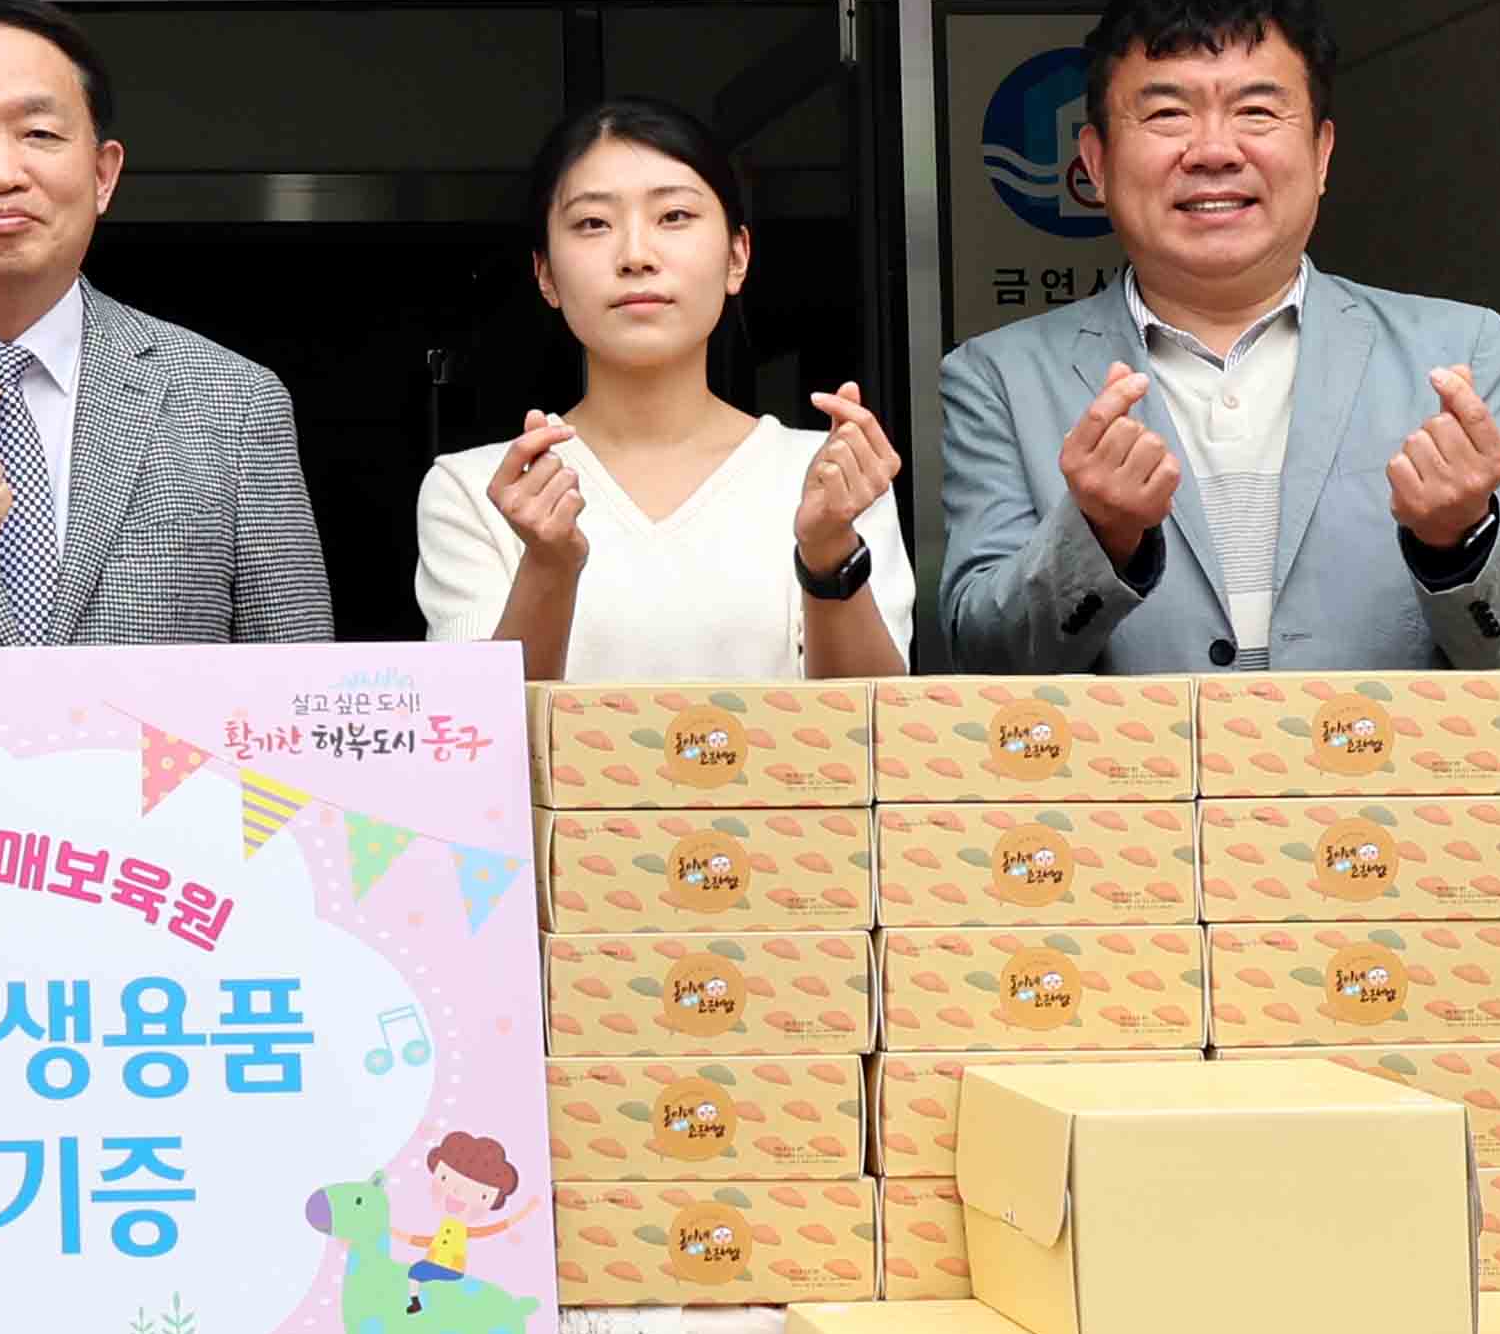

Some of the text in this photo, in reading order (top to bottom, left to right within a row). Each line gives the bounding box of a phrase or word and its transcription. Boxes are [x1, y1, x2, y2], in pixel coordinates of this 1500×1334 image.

[292, 693, 420, 715] 살고 싶은 도시!
[224, 715, 492, 761] 활기찬 행복도시 동구
